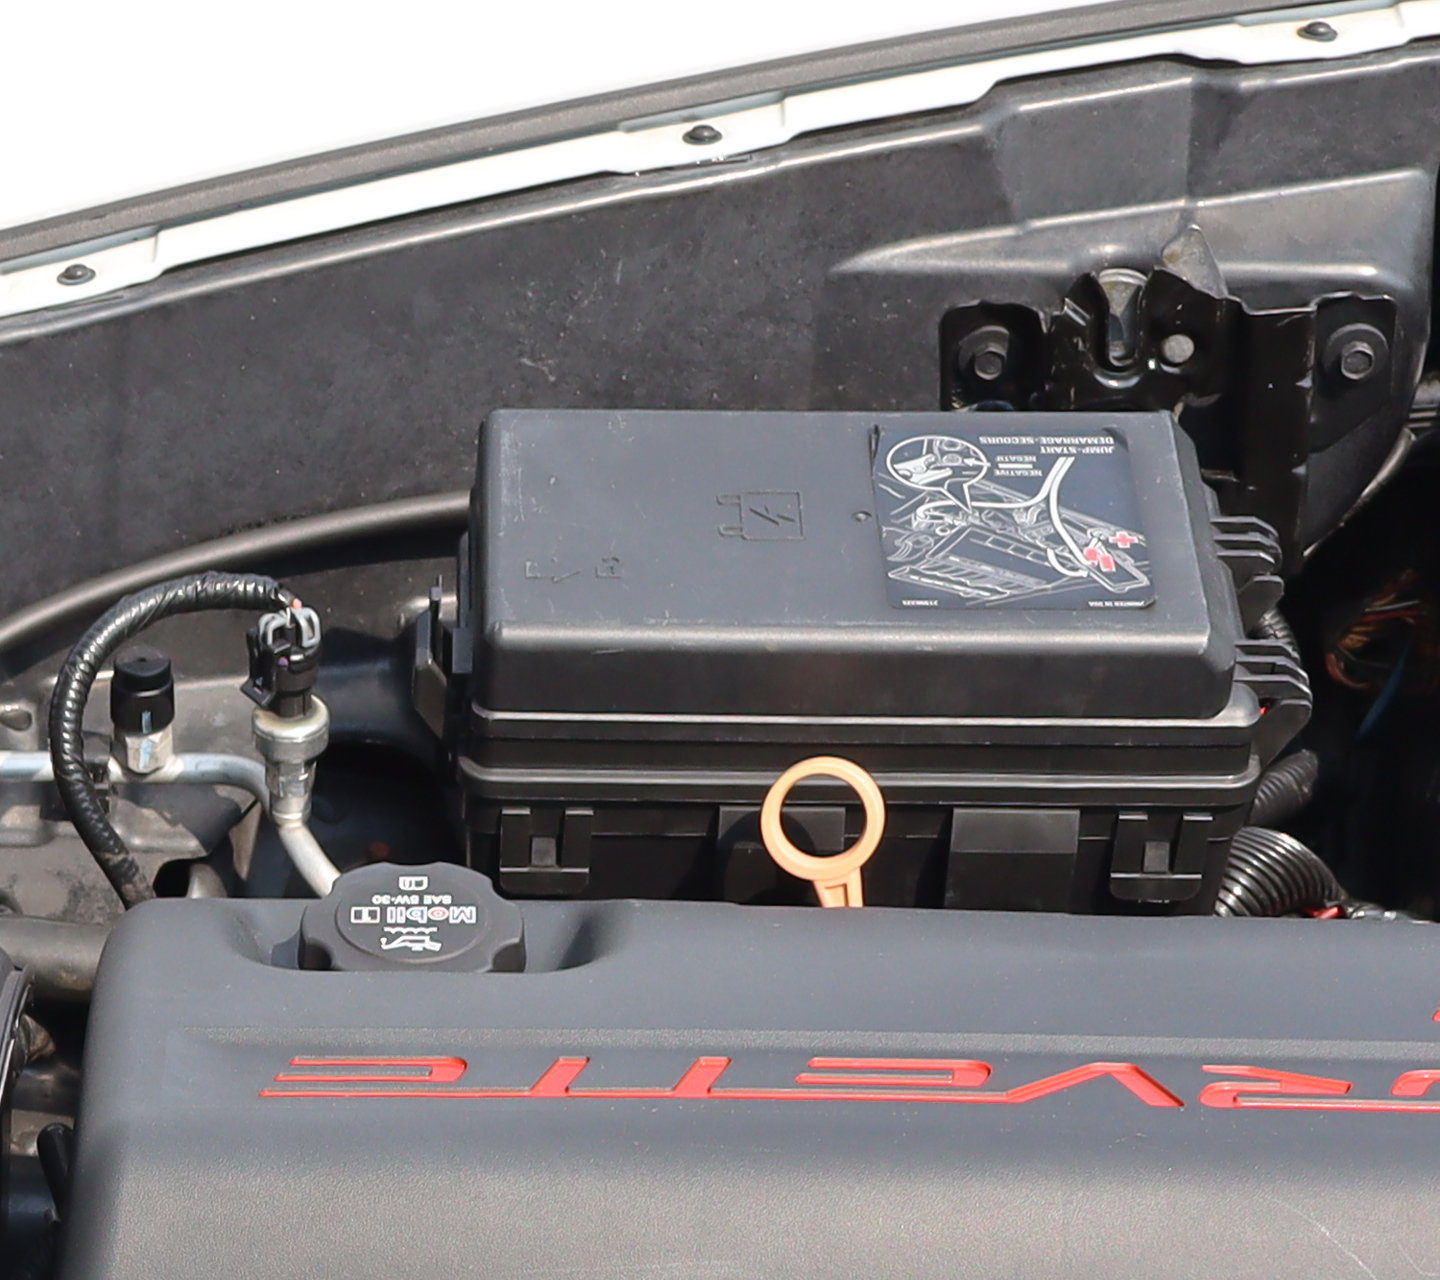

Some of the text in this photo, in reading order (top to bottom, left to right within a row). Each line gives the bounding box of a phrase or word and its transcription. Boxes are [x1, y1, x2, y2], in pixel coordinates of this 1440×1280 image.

[1040, 446, 1115, 454] JUMP-START
[372, 895, 452, 904] SAE 5W-30
[386, 906, 477, 923] Mobil
